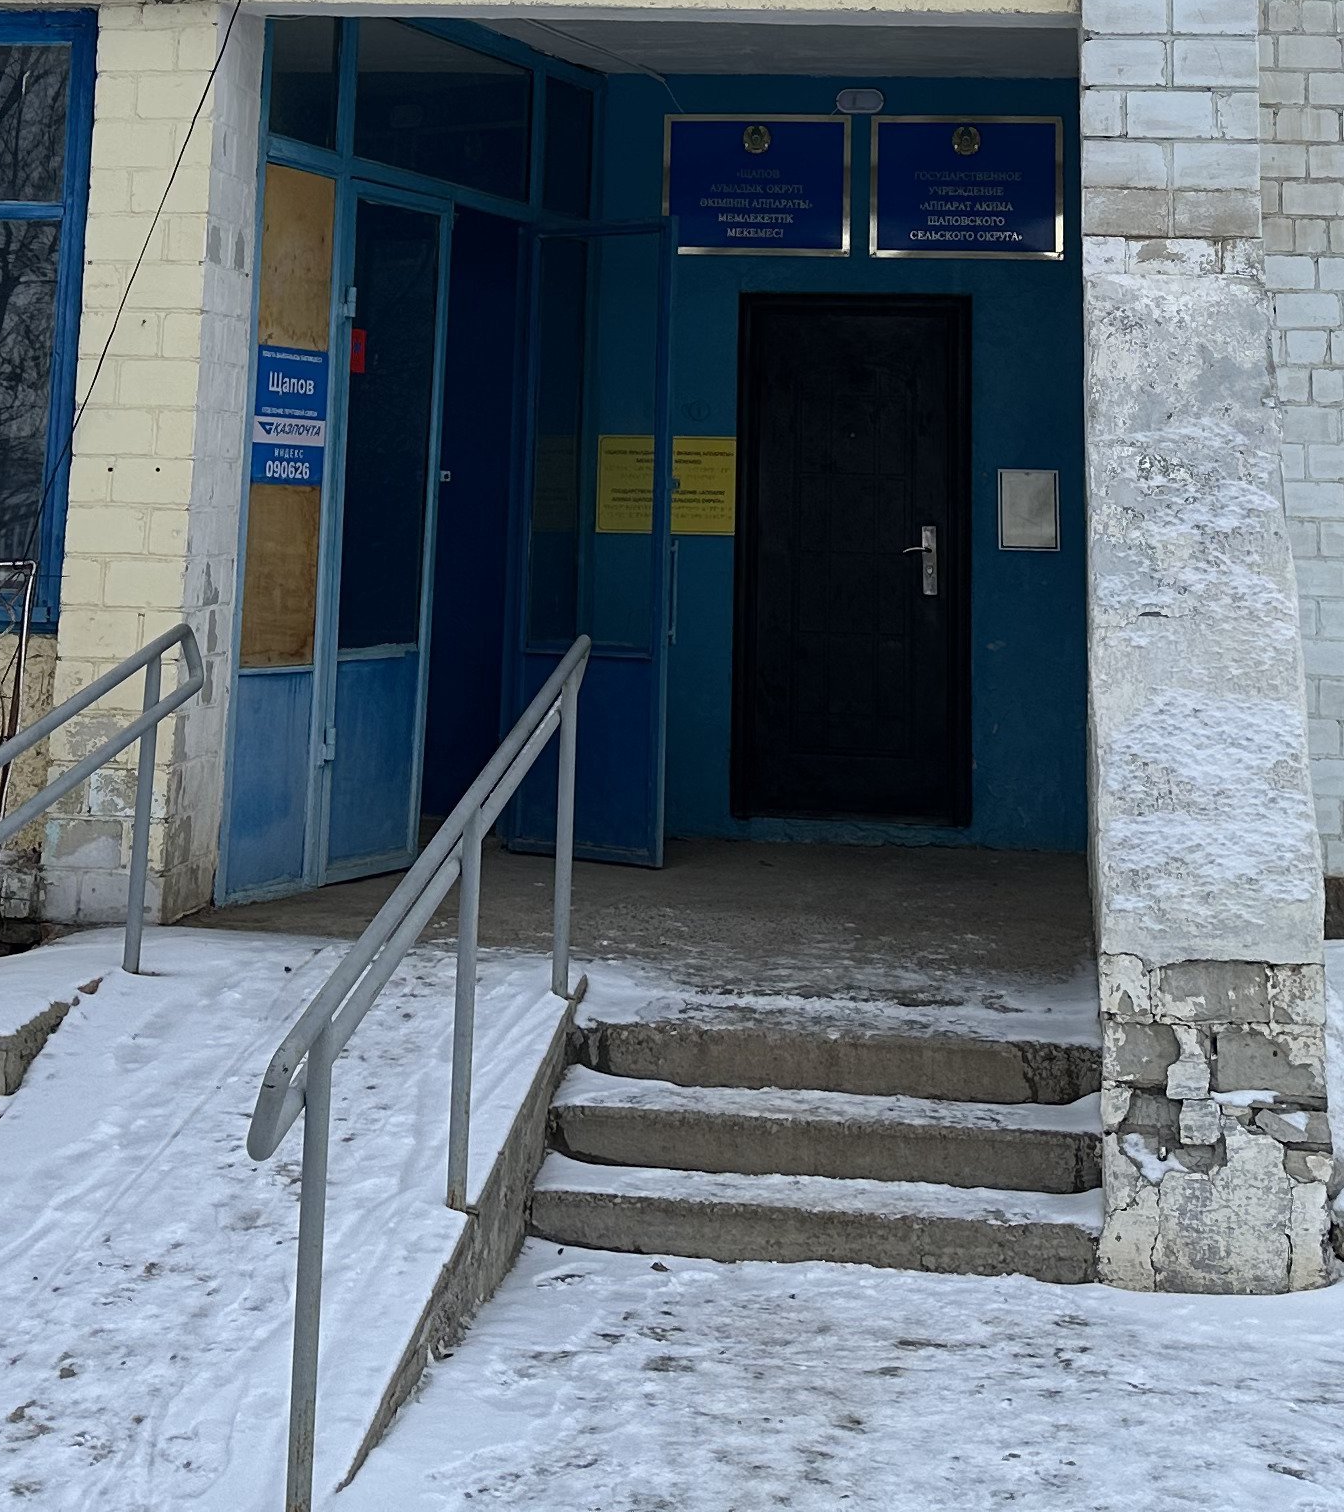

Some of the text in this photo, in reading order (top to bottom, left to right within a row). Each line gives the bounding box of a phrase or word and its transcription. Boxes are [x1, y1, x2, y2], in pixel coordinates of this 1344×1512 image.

[915, 171, 1022, 181] ГОСУДАРСТВЕННОЕ
[929, 186, 1004, 196] УЧРЕЖДЕНИЕ
[975, 201, 1012, 211] АКИМА
[718, 213, 793, 223] МЕМЛЕКЕТТІК
[727, 228, 783, 238] МЕКЕМЕСІ
[909, 231, 974, 241] СЕЛЬСКОГО
[268, 371, 315, 396] Щапов
[274, 448, 304, 459] ИНДЕКС
[265, 460, 309, 479] 090626
